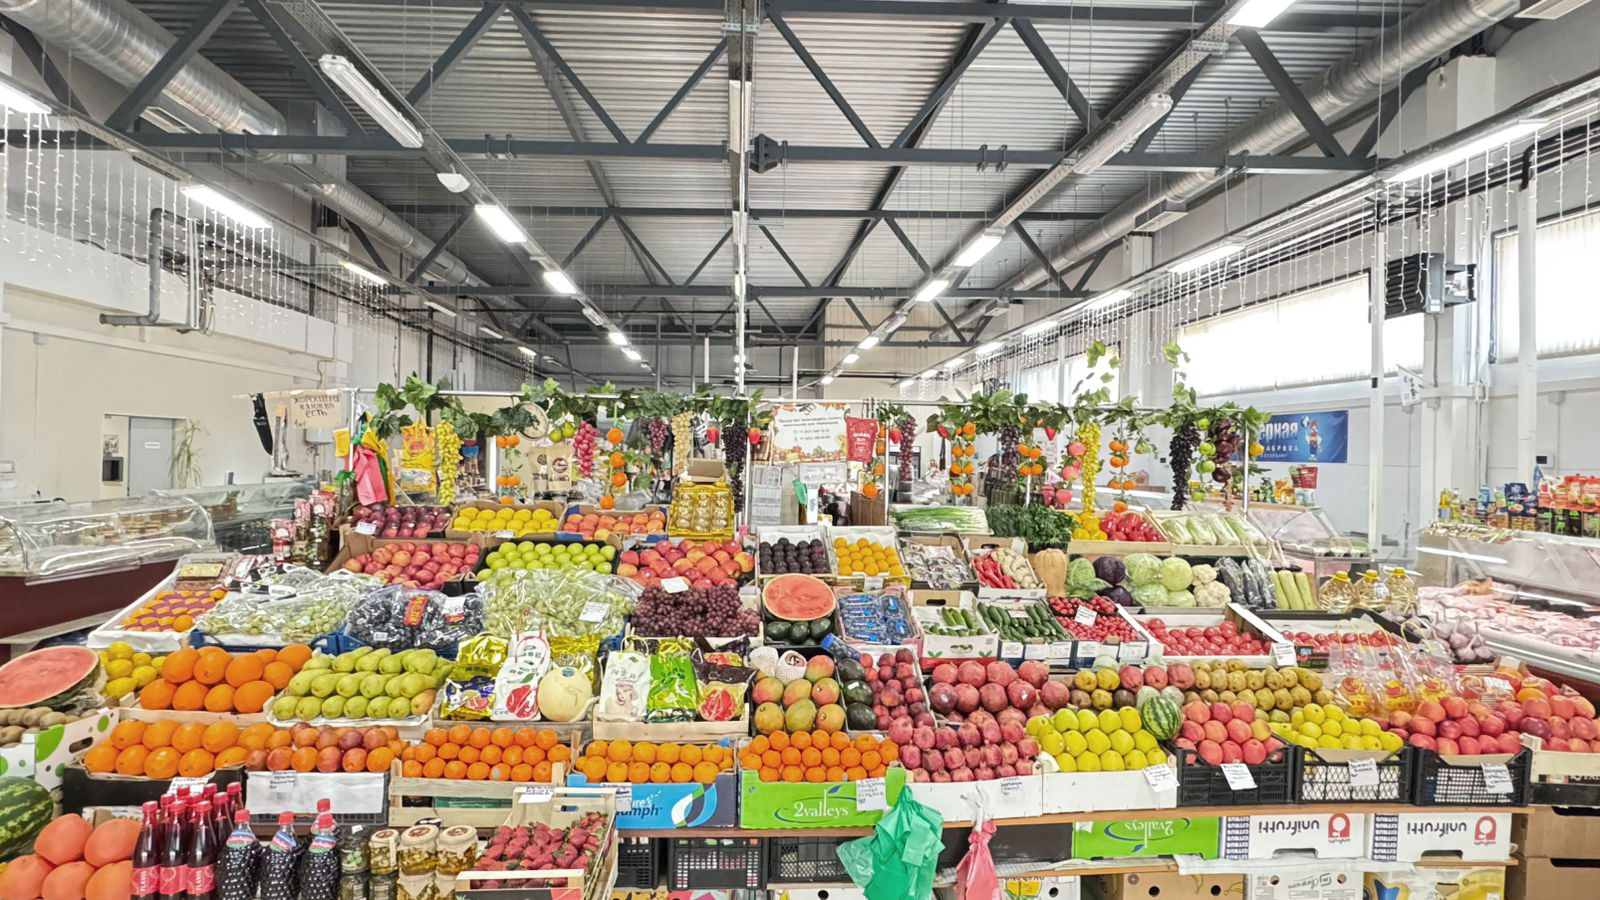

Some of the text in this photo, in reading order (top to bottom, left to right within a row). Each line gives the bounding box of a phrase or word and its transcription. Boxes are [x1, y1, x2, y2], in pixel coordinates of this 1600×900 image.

[1258, 422, 1298, 440] ерная
[1264, 444, 1299, 452] АБРИКА
[793, 789, 849, 819] 2valleys
[1125, 820, 1174, 848] 2valleys
[1259, 820, 1320, 836] unifrutti
[1407, 822, 1467, 838] unifrutti
